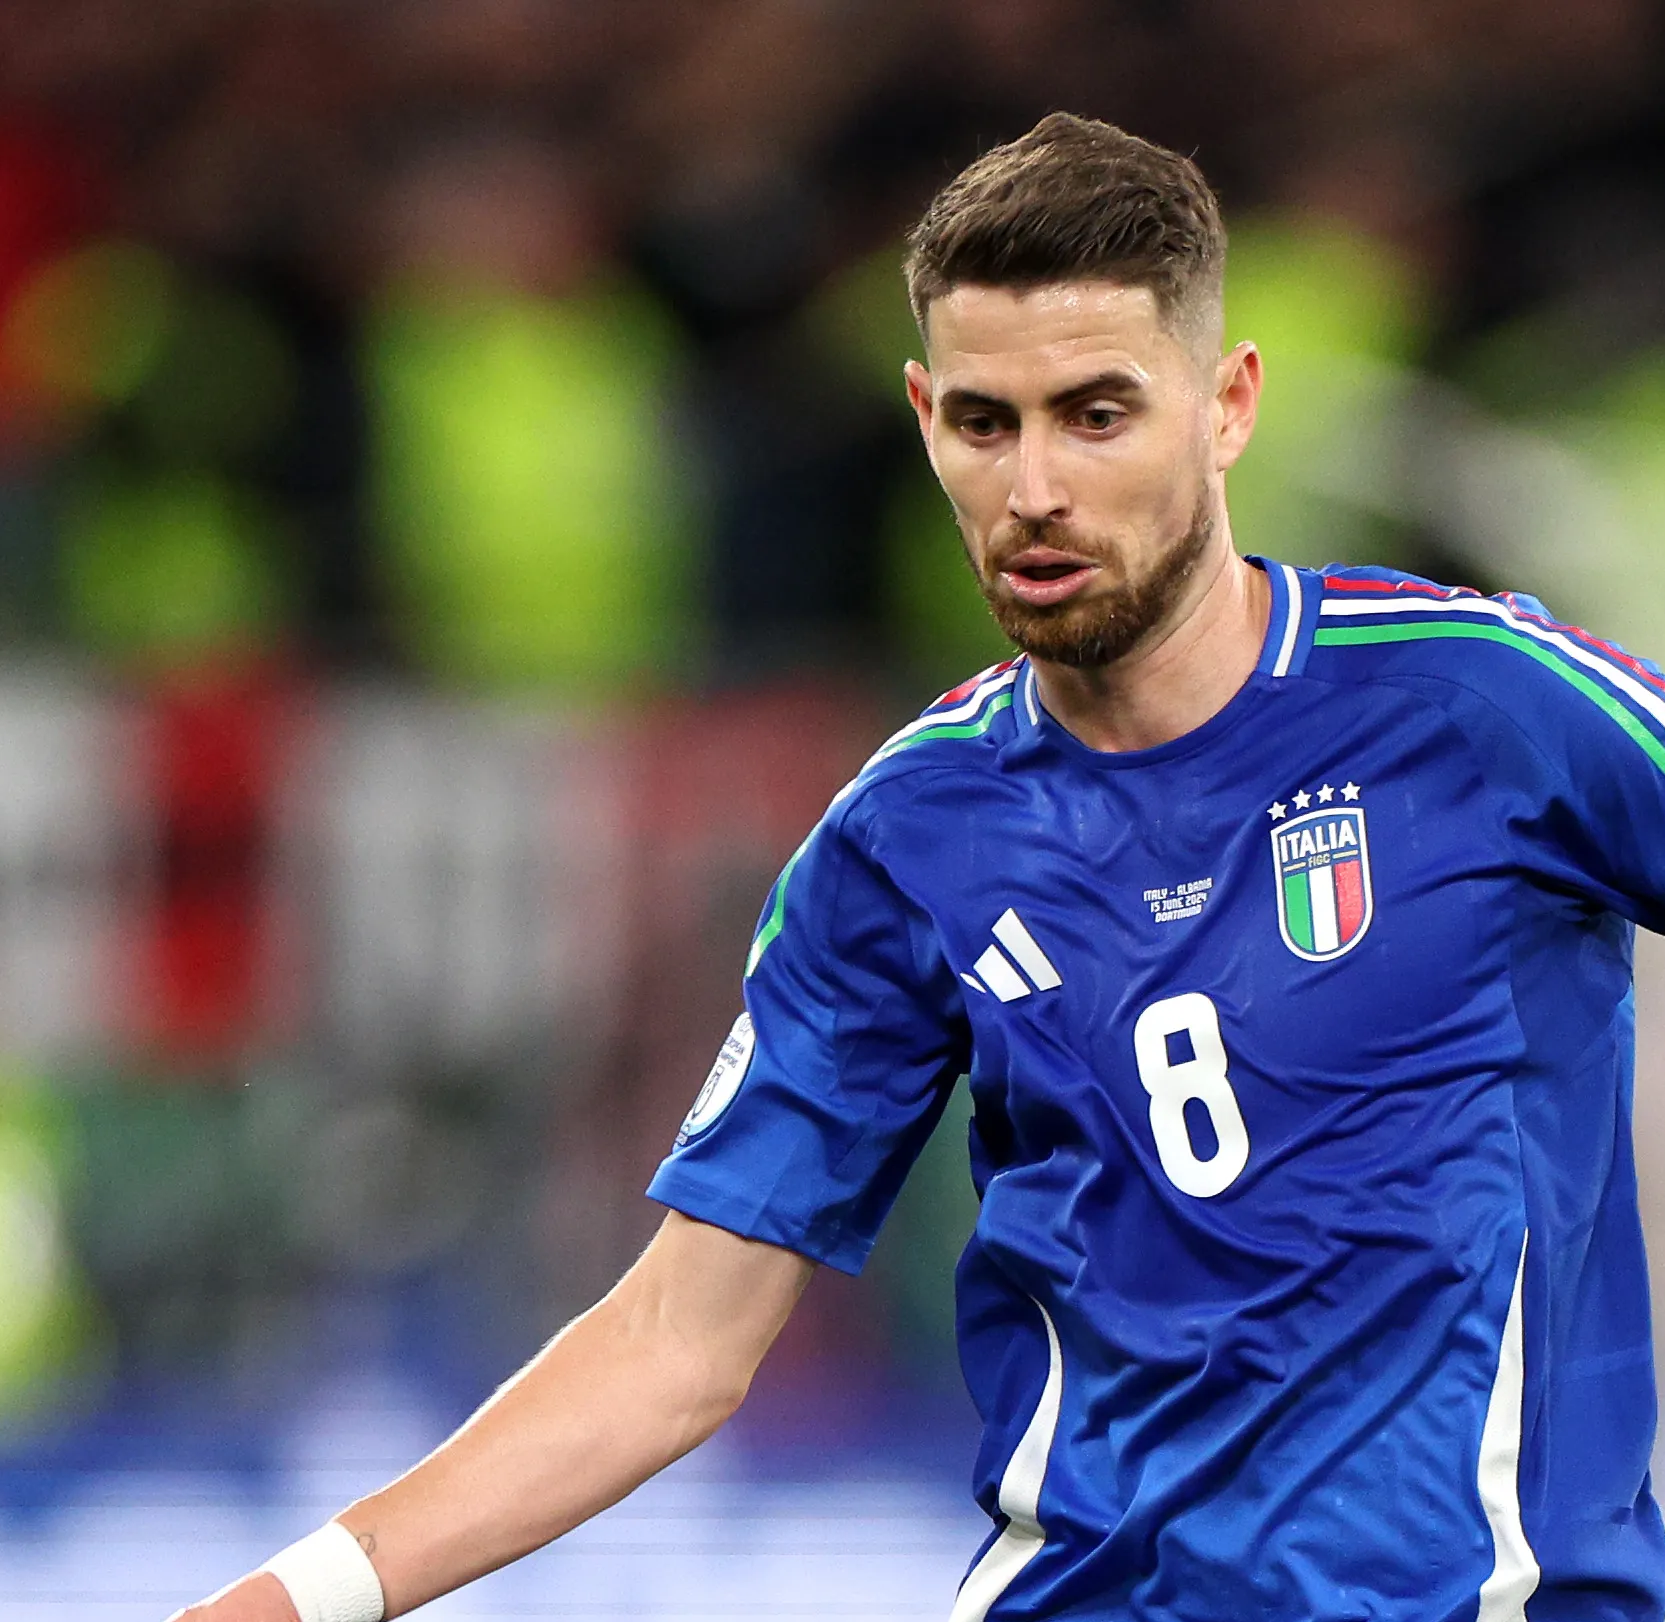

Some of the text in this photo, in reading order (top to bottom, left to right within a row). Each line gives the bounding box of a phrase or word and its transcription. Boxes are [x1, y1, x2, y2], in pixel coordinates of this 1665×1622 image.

[1279, 819, 1358, 863] ITALIA
[1308, 853, 1331, 868] FIGC
[1143, 887, 1168, 902] ITALY
[1176, 877, 1213, 896] ALBANIA
[1150, 892, 1208, 913] 15 JUNE 2024
[1154, 904, 1202, 923] DORTMUND
[1133, 992, 1250, 1200] 8
